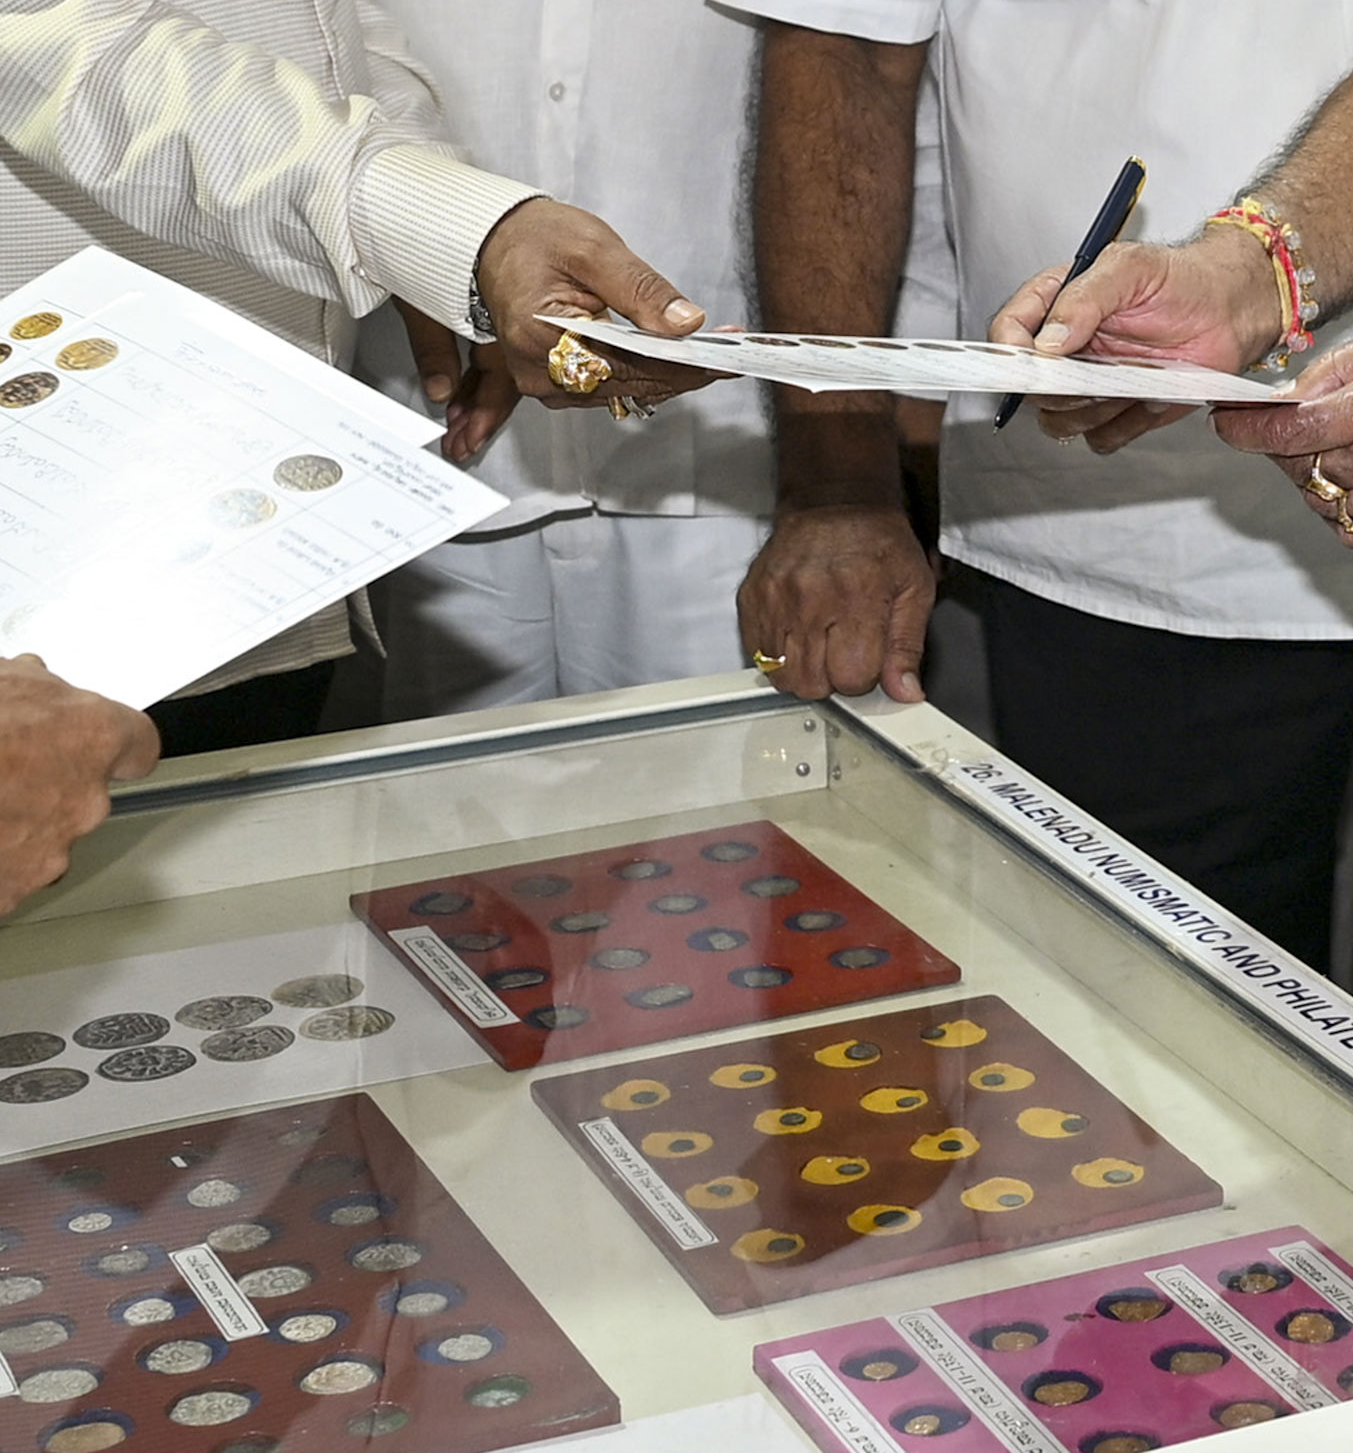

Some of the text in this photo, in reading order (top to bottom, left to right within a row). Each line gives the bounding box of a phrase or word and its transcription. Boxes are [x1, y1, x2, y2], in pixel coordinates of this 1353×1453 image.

[961, 762, 1003, 784] 26.
[987, 782, 1102, 854] MALENADU
[1087, 846, 1233, 943] NUMISMATIC
[1211, 945, 1281, 978] AND
